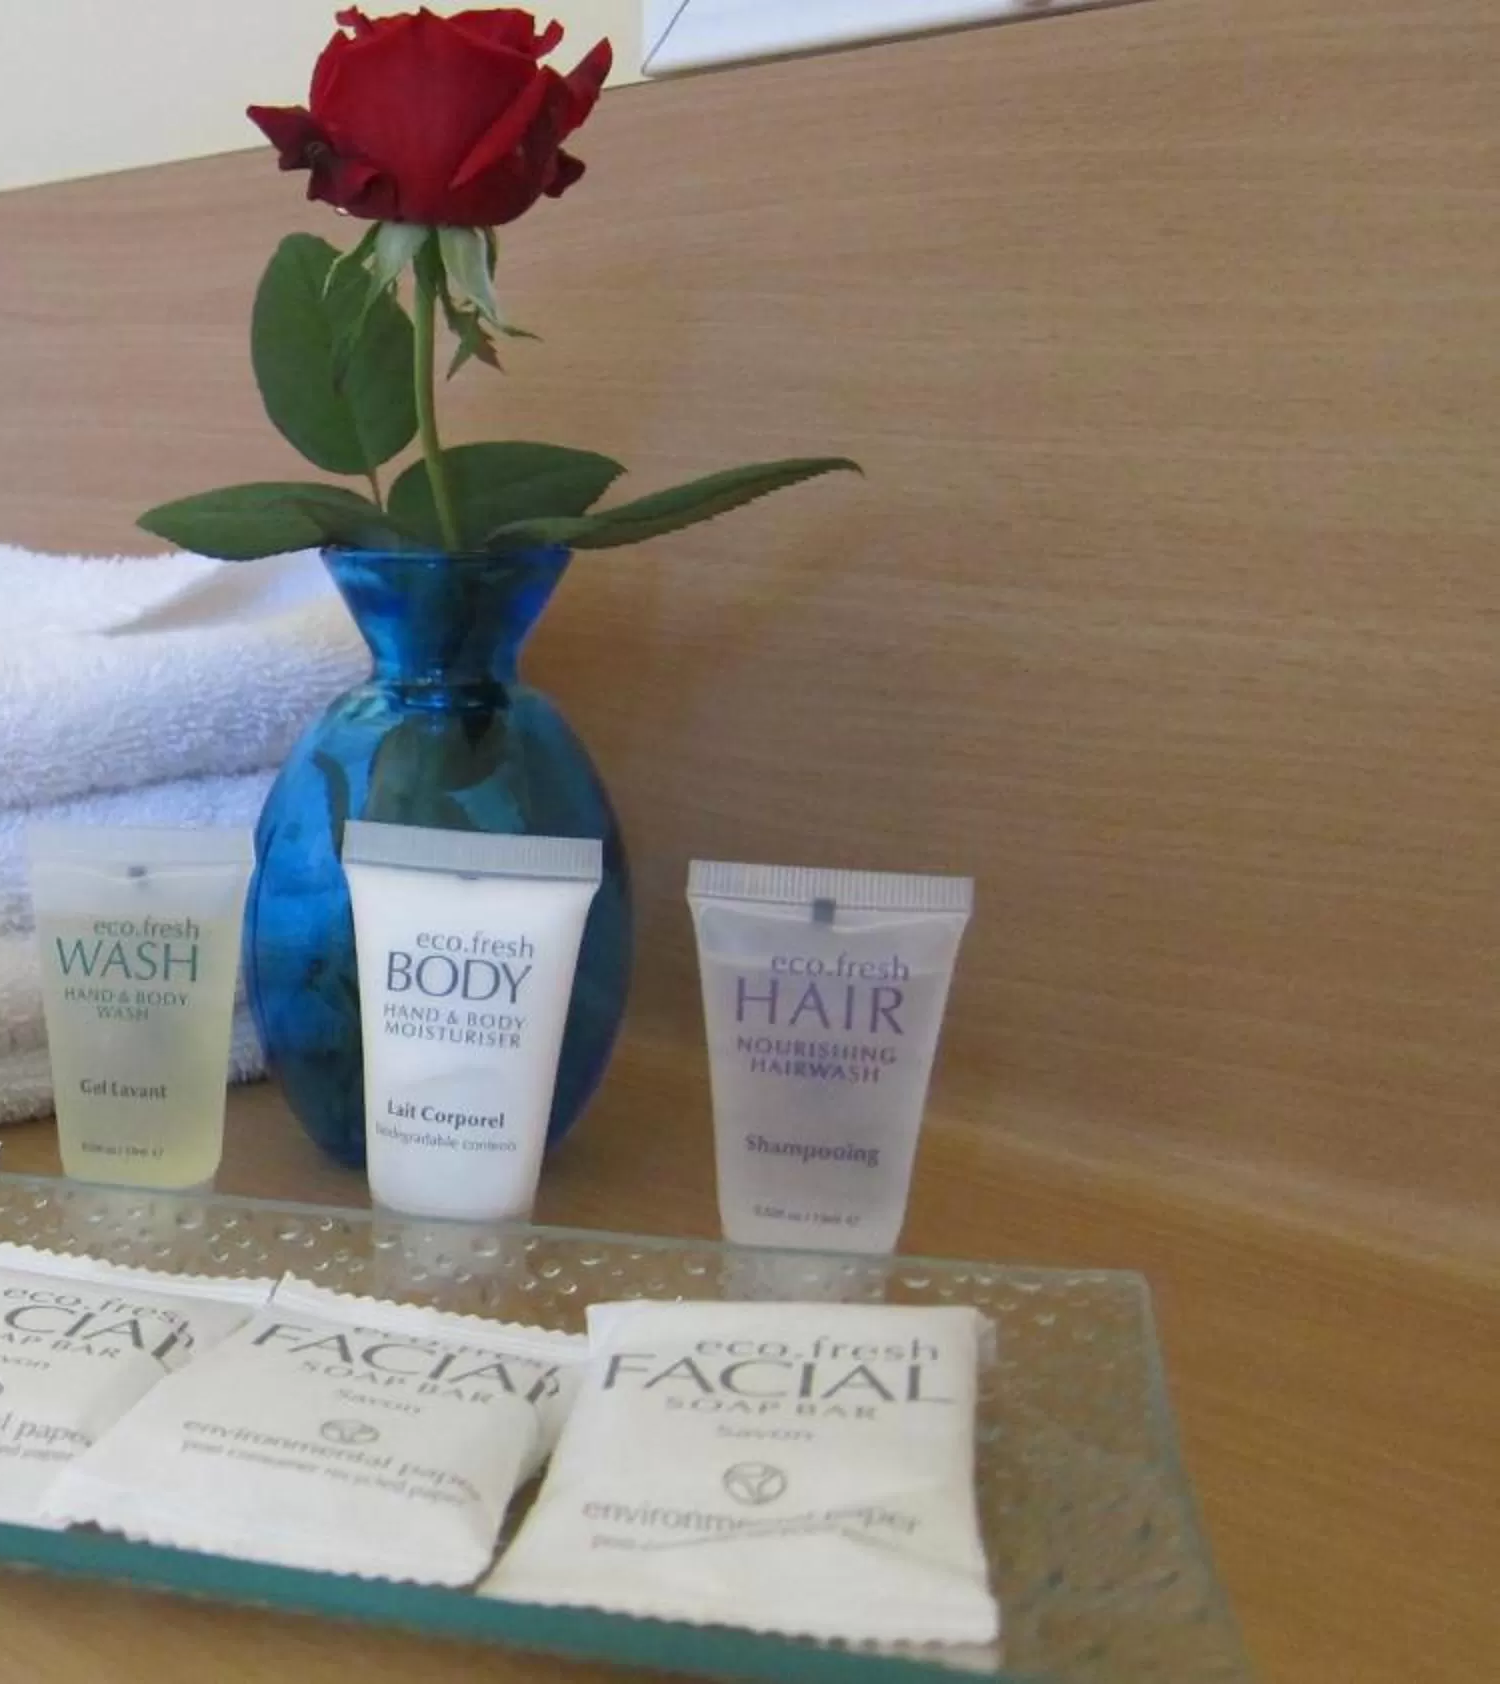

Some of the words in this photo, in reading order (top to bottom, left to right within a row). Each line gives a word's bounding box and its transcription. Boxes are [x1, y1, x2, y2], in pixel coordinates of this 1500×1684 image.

[93, 914, 200, 940] eco.fresh
[55, 936, 199, 982] WASH
[416, 930, 535, 959] eco.fresh
[386, 951, 533, 1005] BODY
[771, 950, 911, 981] eco.fresh
[64, 987, 113, 1003] HAND
[135, 990, 189, 1006] BODY
[736, 975, 905, 1035] HAIR
[96, 1005, 149, 1021] WASH
[383, 1003, 440, 1023] HAND
[447, 1009, 459, 1025] &
[467, 1011, 526, 1030] BODY
[384, 1020, 521, 1048] MOISTURISER
[736, 1035, 898, 1066] NOURISHING
[750, 1057, 881, 1084] HAIRWASH
[387, 1098, 417, 1119] Lait
[421, 1105, 505, 1130] Corporel
[744, 1133, 881, 1168] Shampooing
[2, 1287, 195, 1348] eco.fresh
[50, 1339, 122, 1359] BAR
[694, 1336, 940, 1362] eco.fresh
[302, 1360, 406, 1386] SOAP
[417, 1381, 493, 1404] BAR
[601, 1353, 955, 1405] FACIAL
[663, 1396, 782, 1416] SOAP
[795, 1402, 878, 1421] BAR
[182, 1420, 393, 1468] environmental
[715, 1423, 818, 1443] Savon
